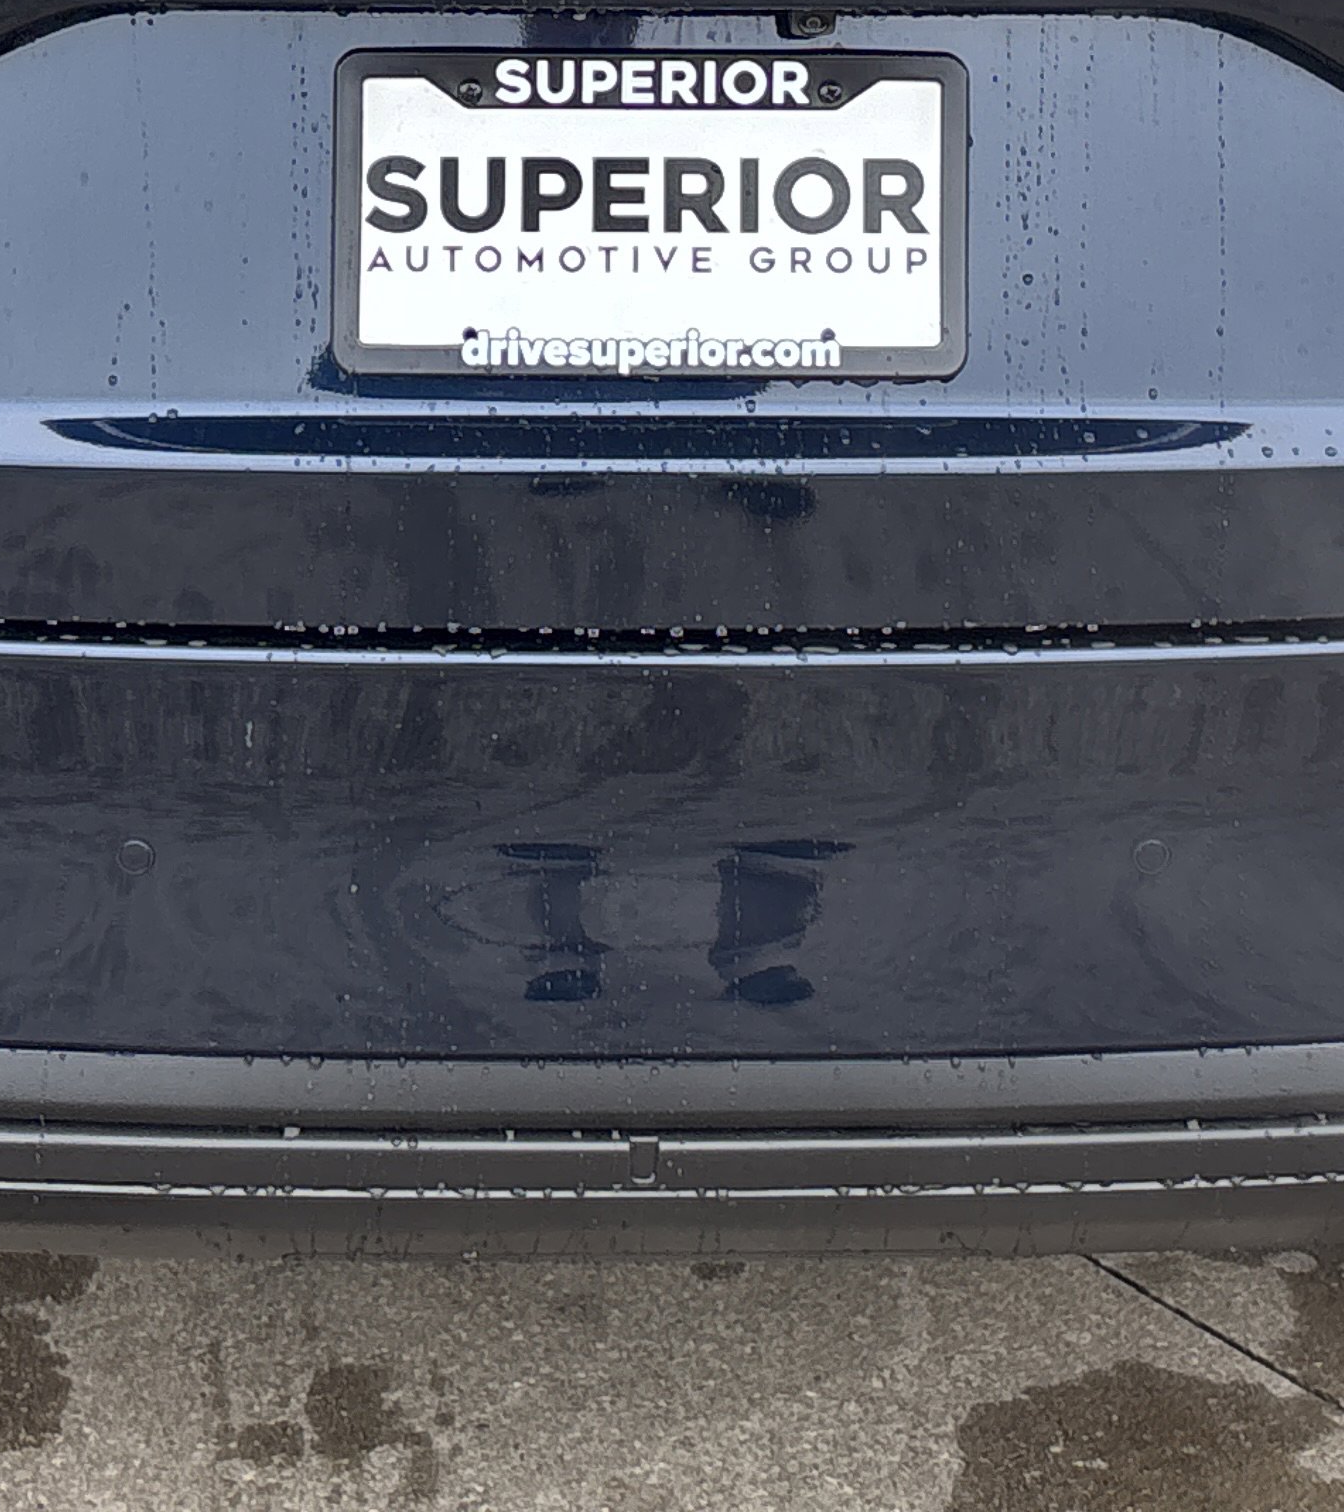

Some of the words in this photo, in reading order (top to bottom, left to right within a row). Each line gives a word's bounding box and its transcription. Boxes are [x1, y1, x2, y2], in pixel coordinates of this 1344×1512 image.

[494, 59, 810, 106] SUPERIOR
[365, 156, 930, 234] SUPERIOR
[367, 245, 713, 274] AUTOMOTIVE
[749, 246, 928, 274] GROUP
[461, 327, 841, 375] drivesuperior.com
